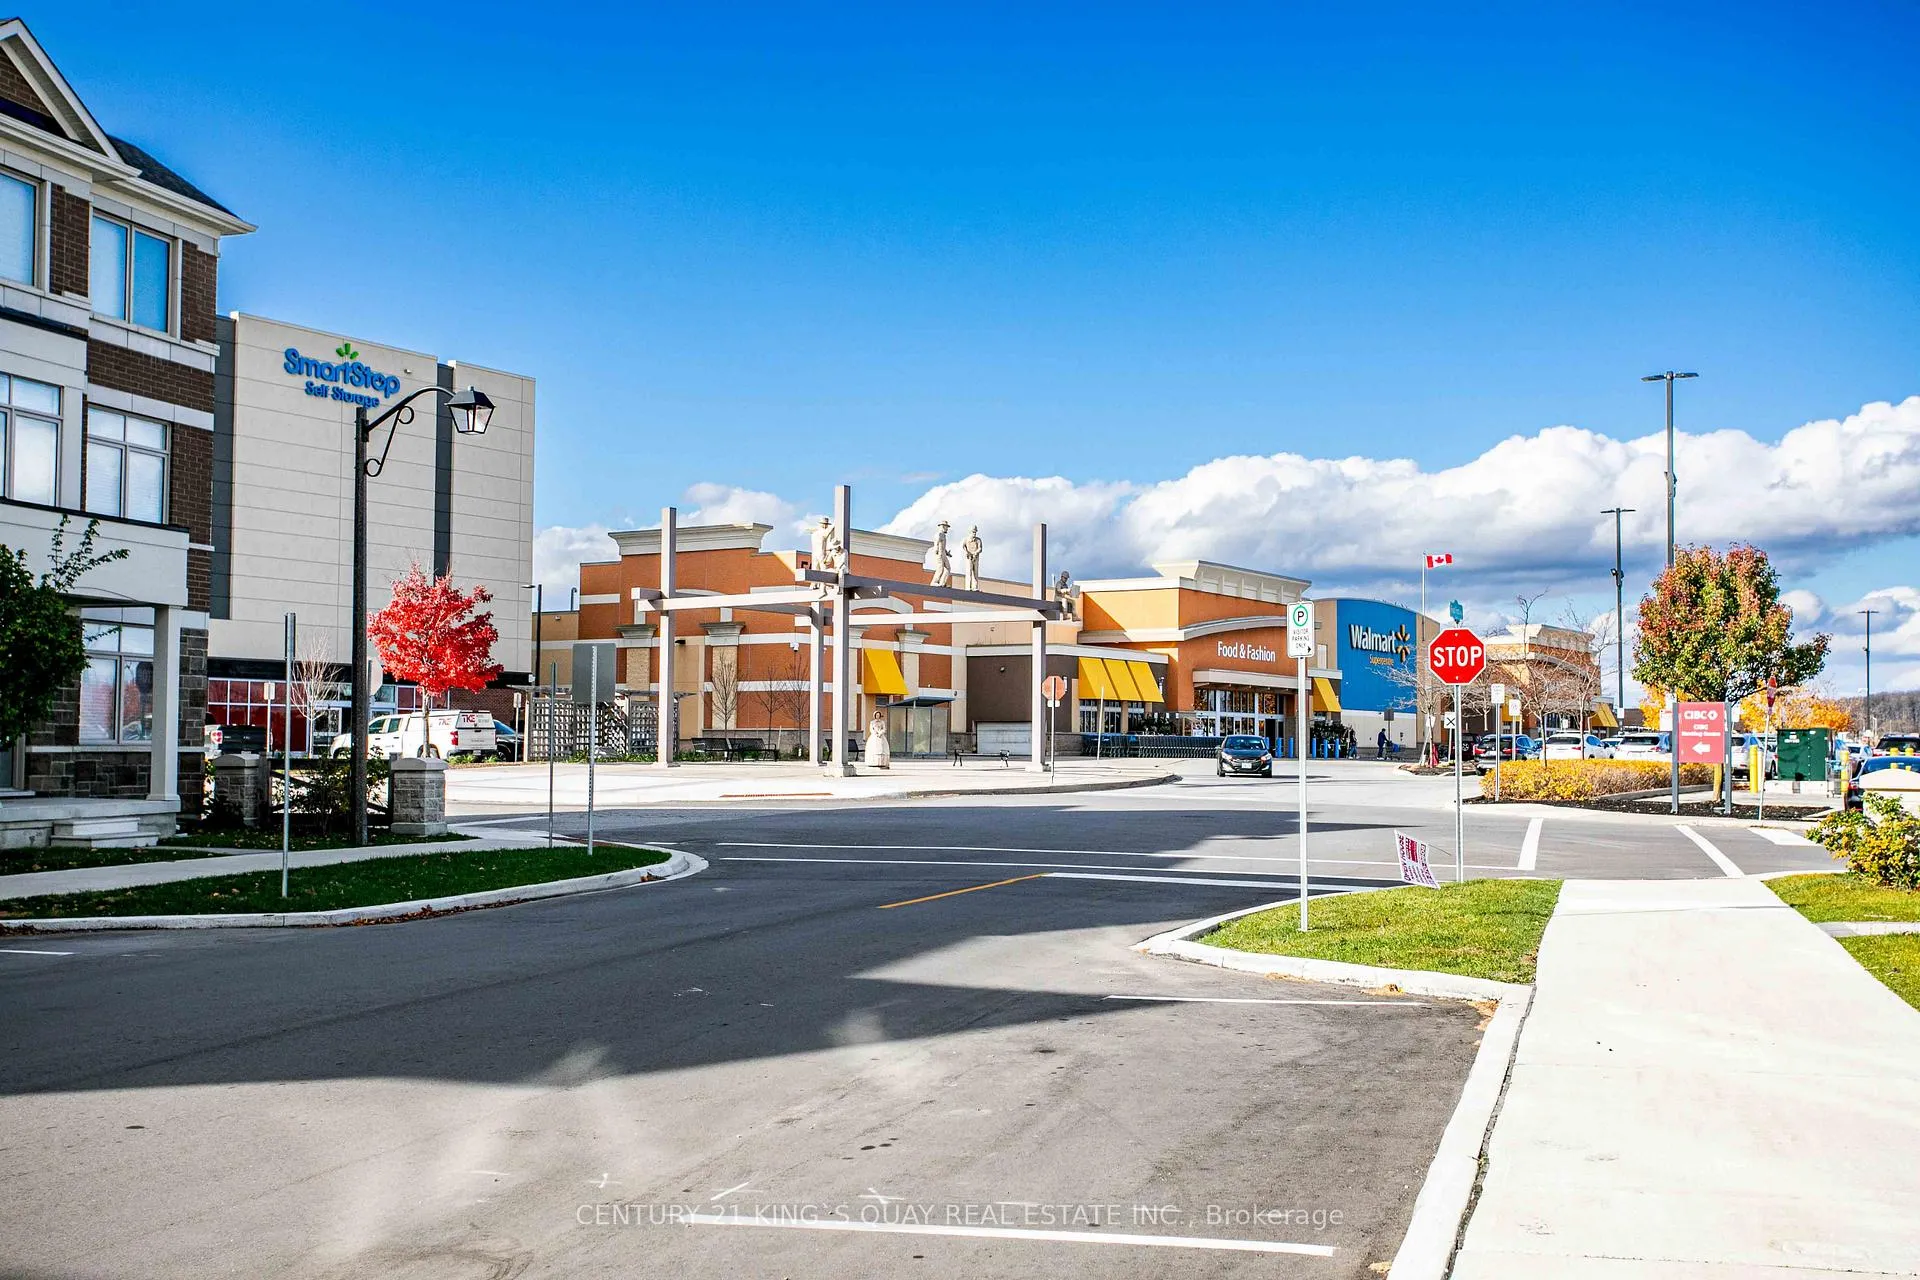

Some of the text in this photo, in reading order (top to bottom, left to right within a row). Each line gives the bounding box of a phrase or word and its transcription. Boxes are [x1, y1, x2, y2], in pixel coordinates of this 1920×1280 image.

[284, 348, 401, 399] SmartStop
[305, 381, 381, 408] Self Storage
[1350, 623, 1397, 654] Walmart
[1217, 641, 1276, 662] Food & Fashion
[1433, 645, 1483, 668] STOP
[1684, 710, 1707, 720] CIBC
